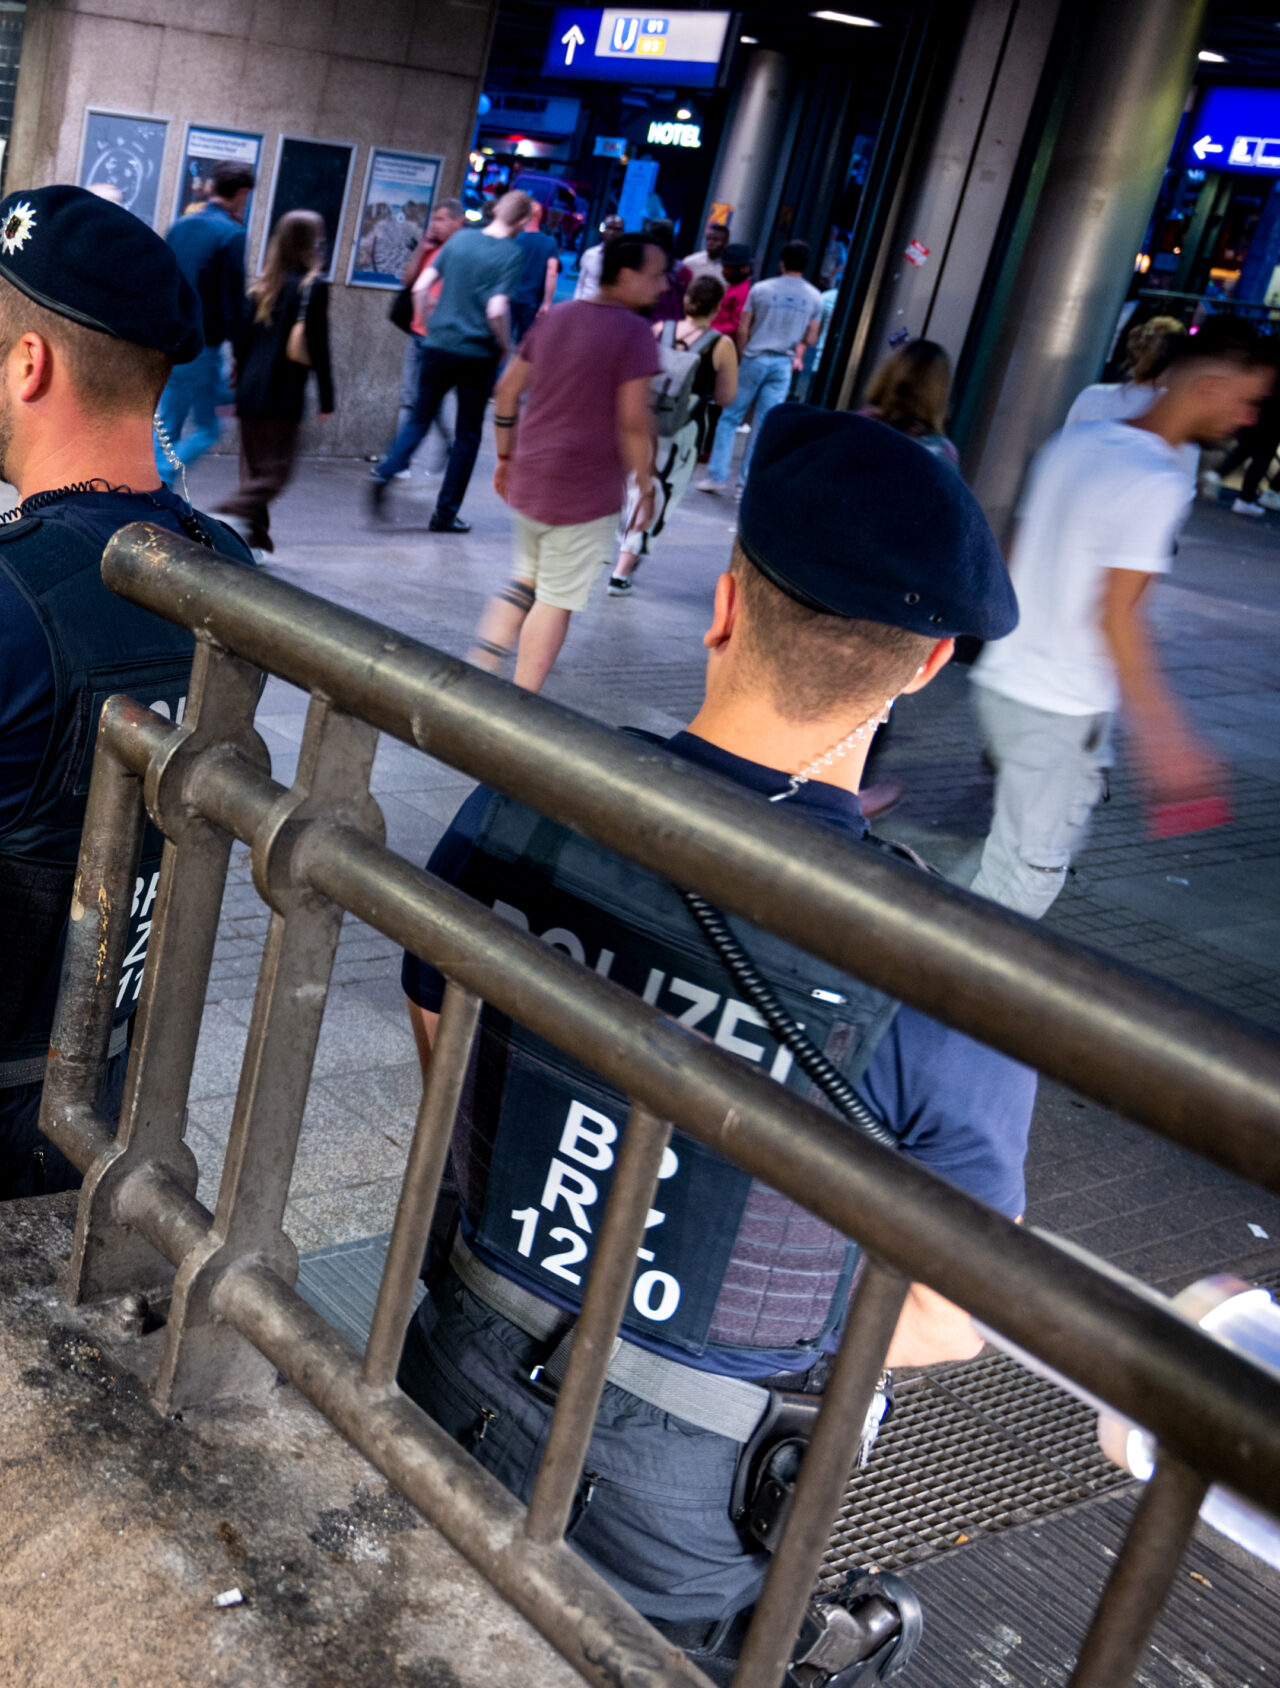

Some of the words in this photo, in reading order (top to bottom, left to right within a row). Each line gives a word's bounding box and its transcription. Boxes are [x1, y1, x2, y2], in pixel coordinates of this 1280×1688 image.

[613, 18, 639, 51] U
[647, 121, 702, 148] HOTEL
[511, 1206, 681, 1322] 120
